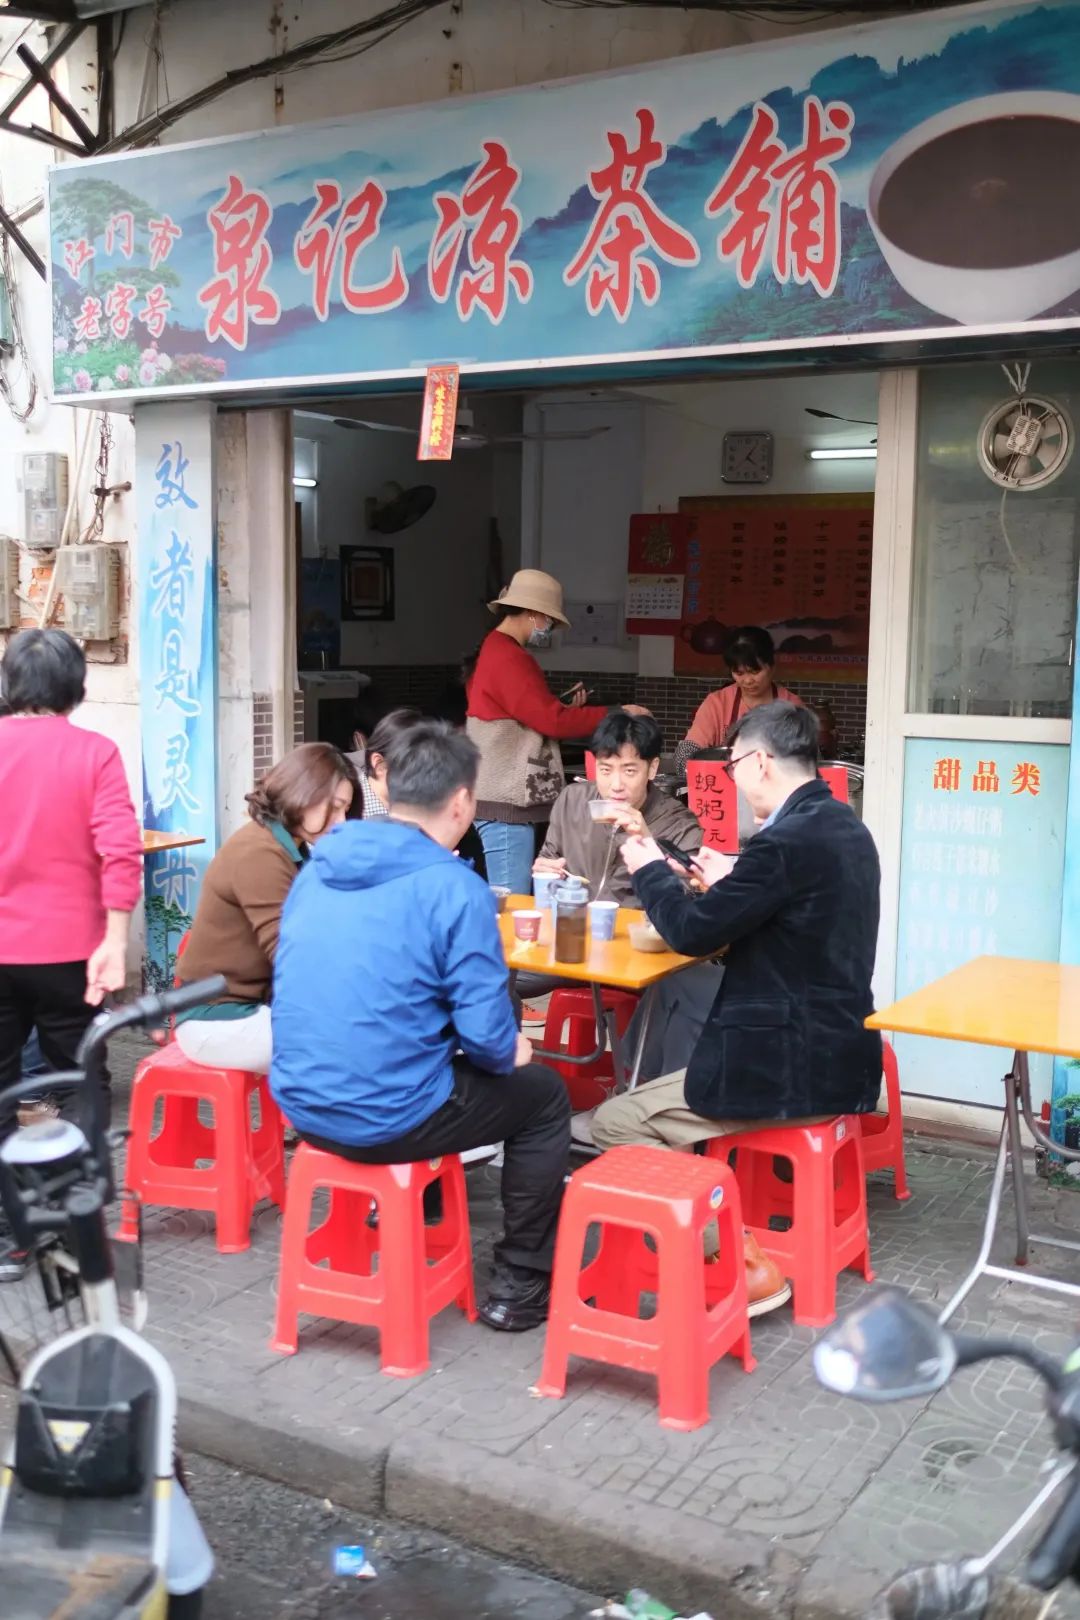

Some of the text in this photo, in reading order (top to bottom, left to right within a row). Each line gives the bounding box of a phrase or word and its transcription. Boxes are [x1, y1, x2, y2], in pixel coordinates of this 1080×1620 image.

[64, 211, 181, 271] 江门市
[201, 98, 853, 348] 泉记凉茶铺
[75, 283, 171, 340] 老字号
[152, 440, 200, 915] 效者是灵丹
[933, 758, 1041, 796] 甜品类
